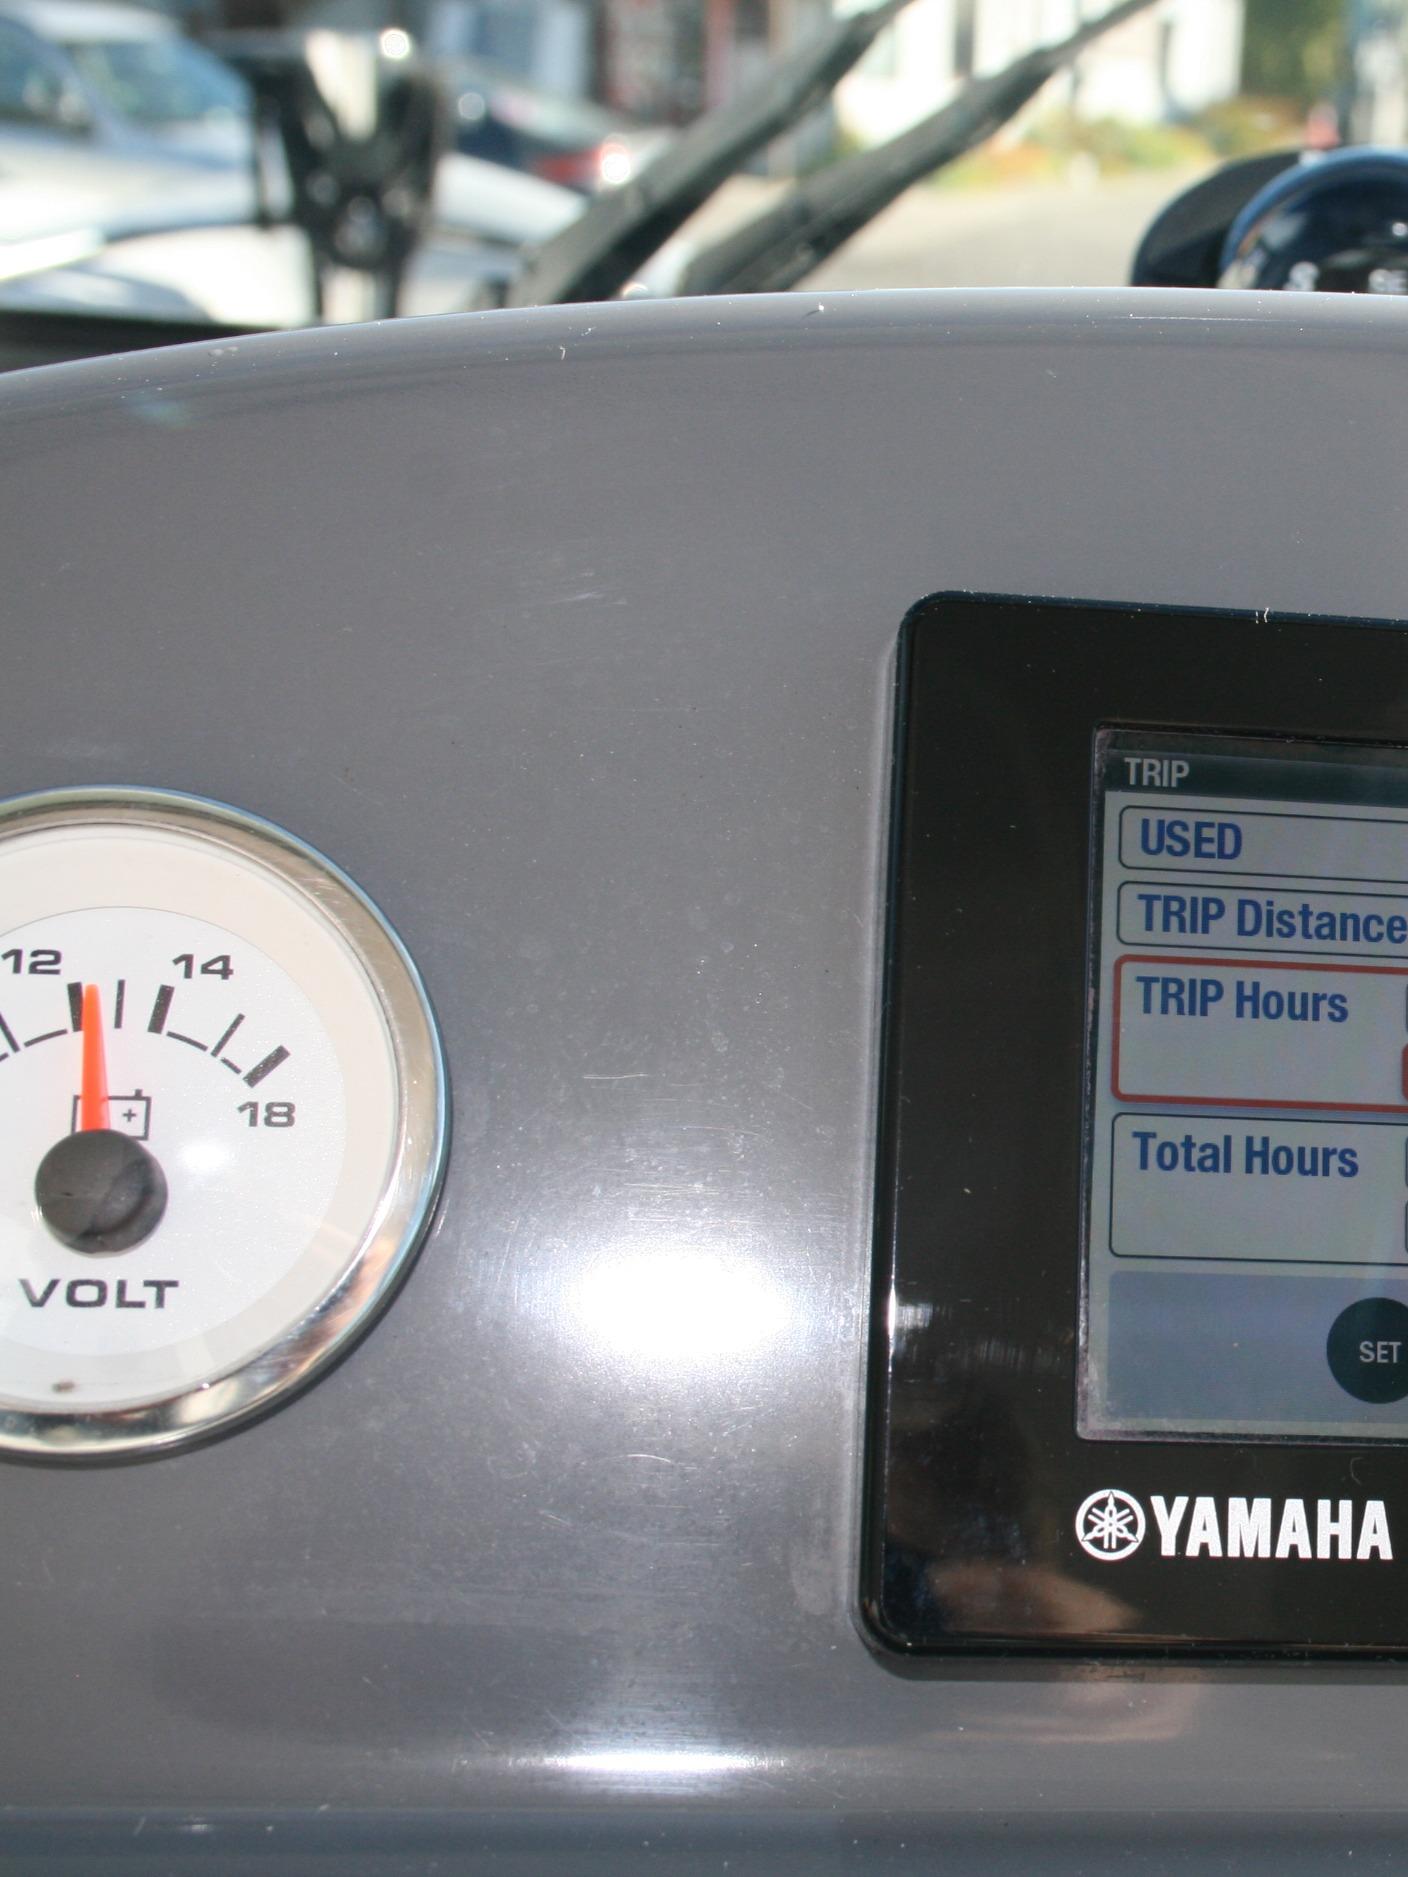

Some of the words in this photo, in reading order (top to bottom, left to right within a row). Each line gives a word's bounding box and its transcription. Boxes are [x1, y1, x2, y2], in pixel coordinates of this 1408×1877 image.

[1124, 757, 1190, 788] TRIP
[1140, 819, 1242, 860] USED
[1137, 894, 1225, 935] TRIP
[1237, 899, 1408, 944] Distance
[1, 949, 62, 975] 12
[172, 954, 234, 980] 14
[1135, 976, 1224, 1017] TRIP
[1236, 980, 1348, 1023] Hours
[236, 1101, 296, 1129] 18
[1132, 1132, 1232, 1174] Total
[1244, 1136, 1358, 1178] Hours
[19, 1277, 179, 1309] VOLT
[1359, 1341, 1401, 1364] SET
[1150, 1496, 1394, 1560] YAMAHA
